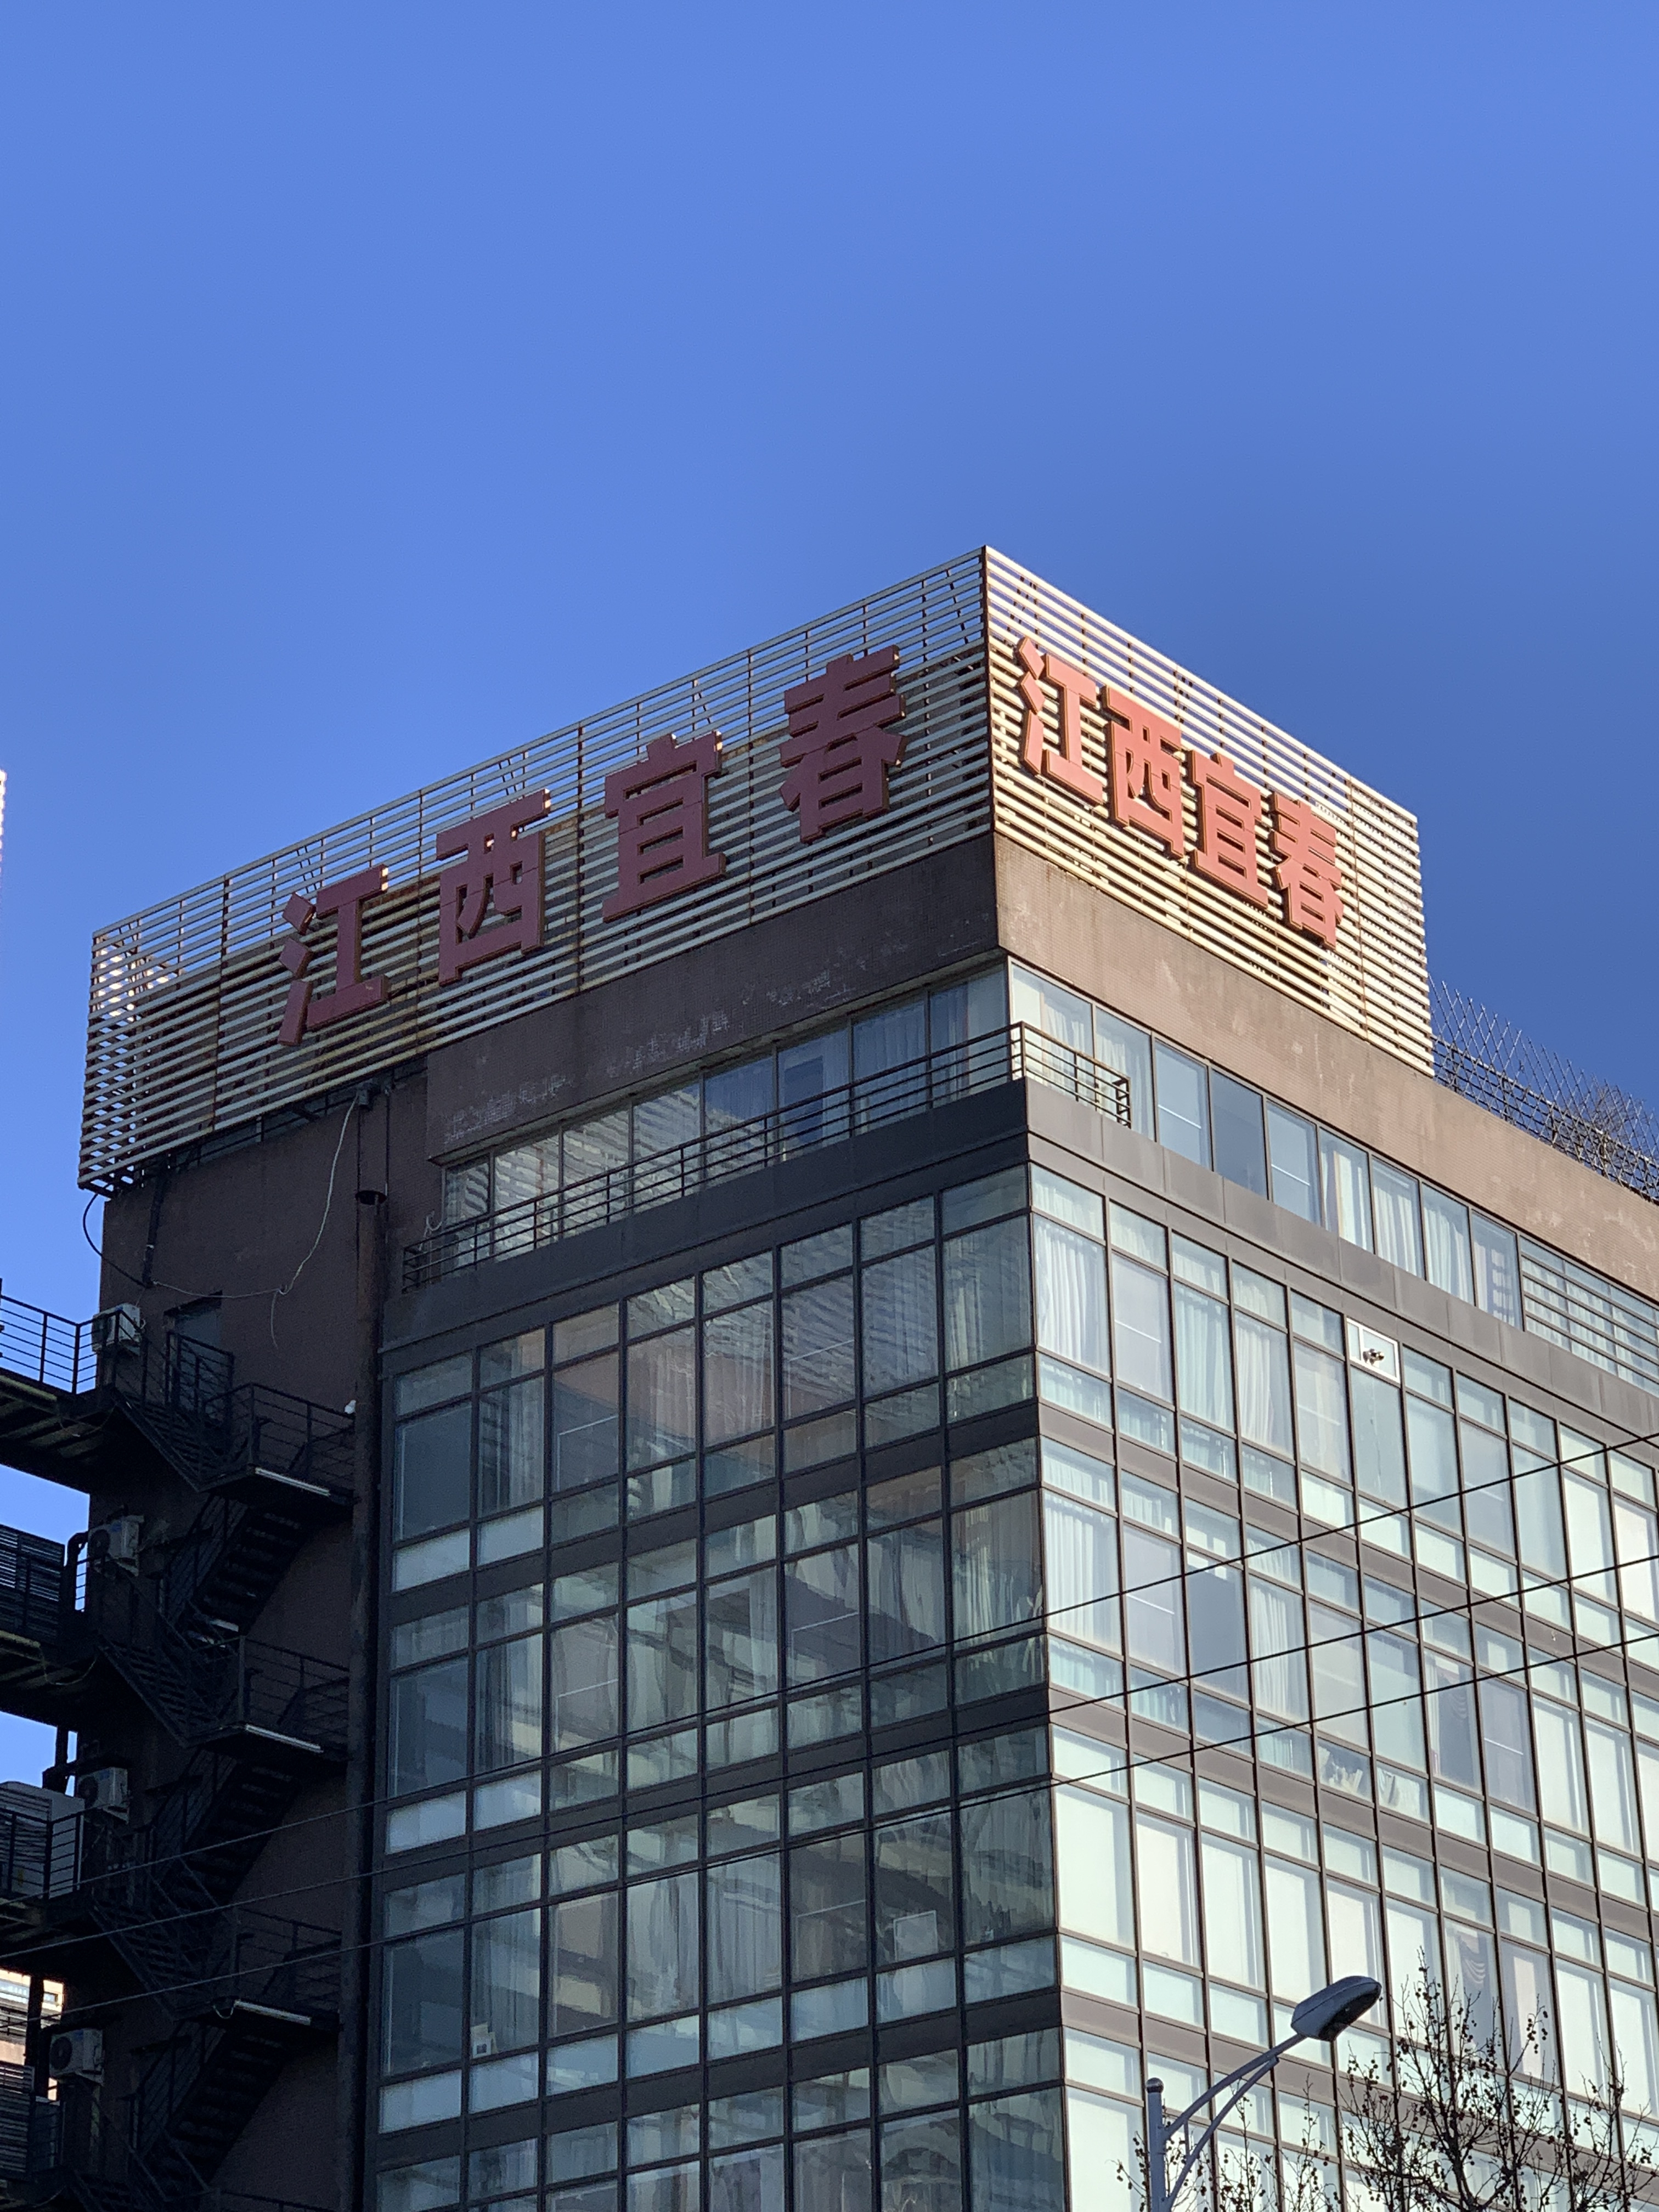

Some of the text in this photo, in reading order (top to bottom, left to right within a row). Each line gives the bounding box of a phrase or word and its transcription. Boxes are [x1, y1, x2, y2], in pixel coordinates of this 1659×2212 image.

[278, 645, 907, 1046] 江西宜春
[1017, 636, 1344, 950] 江西宜春
